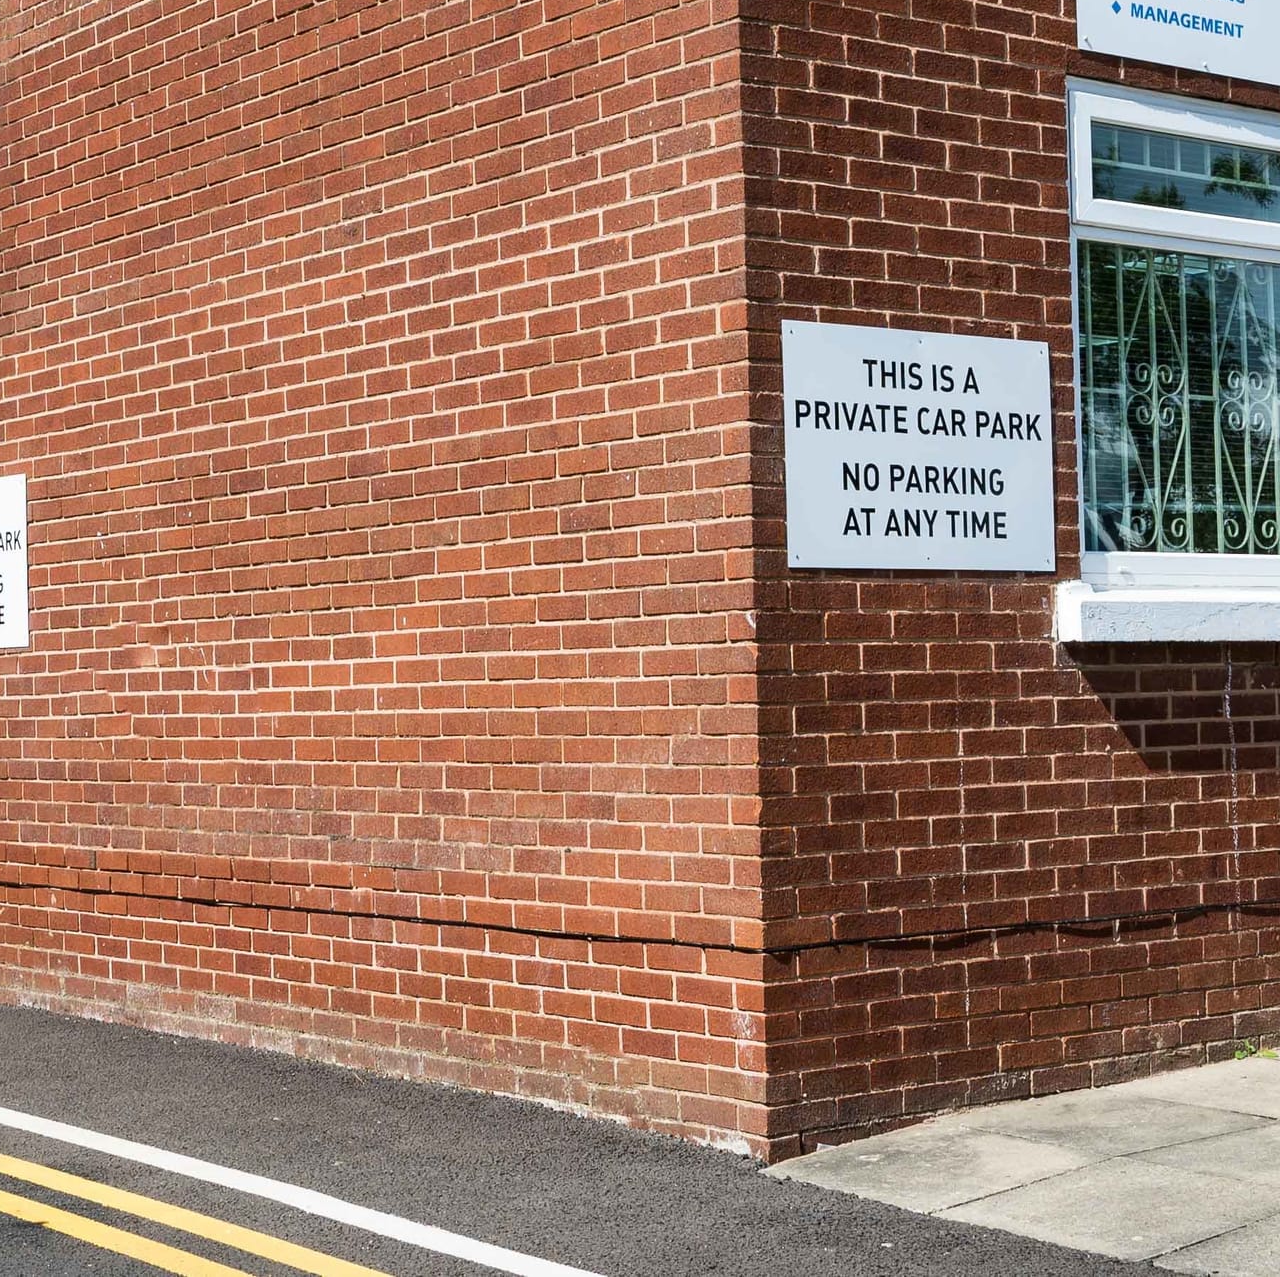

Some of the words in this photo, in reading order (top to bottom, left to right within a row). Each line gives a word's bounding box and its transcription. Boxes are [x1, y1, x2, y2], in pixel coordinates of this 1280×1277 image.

[1131, 3, 1244, 38] MANAGEMENT
[863, 358, 923, 390] THIS
[932, 364, 955, 393] IS
[963, 367, 980, 394] A
[795, 399, 908, 434] PRIVATE
[917, 407, 967, 437] CAR
[976, 410, 1042, 441] PARK
[843, 462, 880, 492] NO
[890, 464, 1004, 496] PARKING
[843, 507, 875, 536] AT
[884, 509, 938, 537] ANY
[946, 510, 1007, 539] TIME
